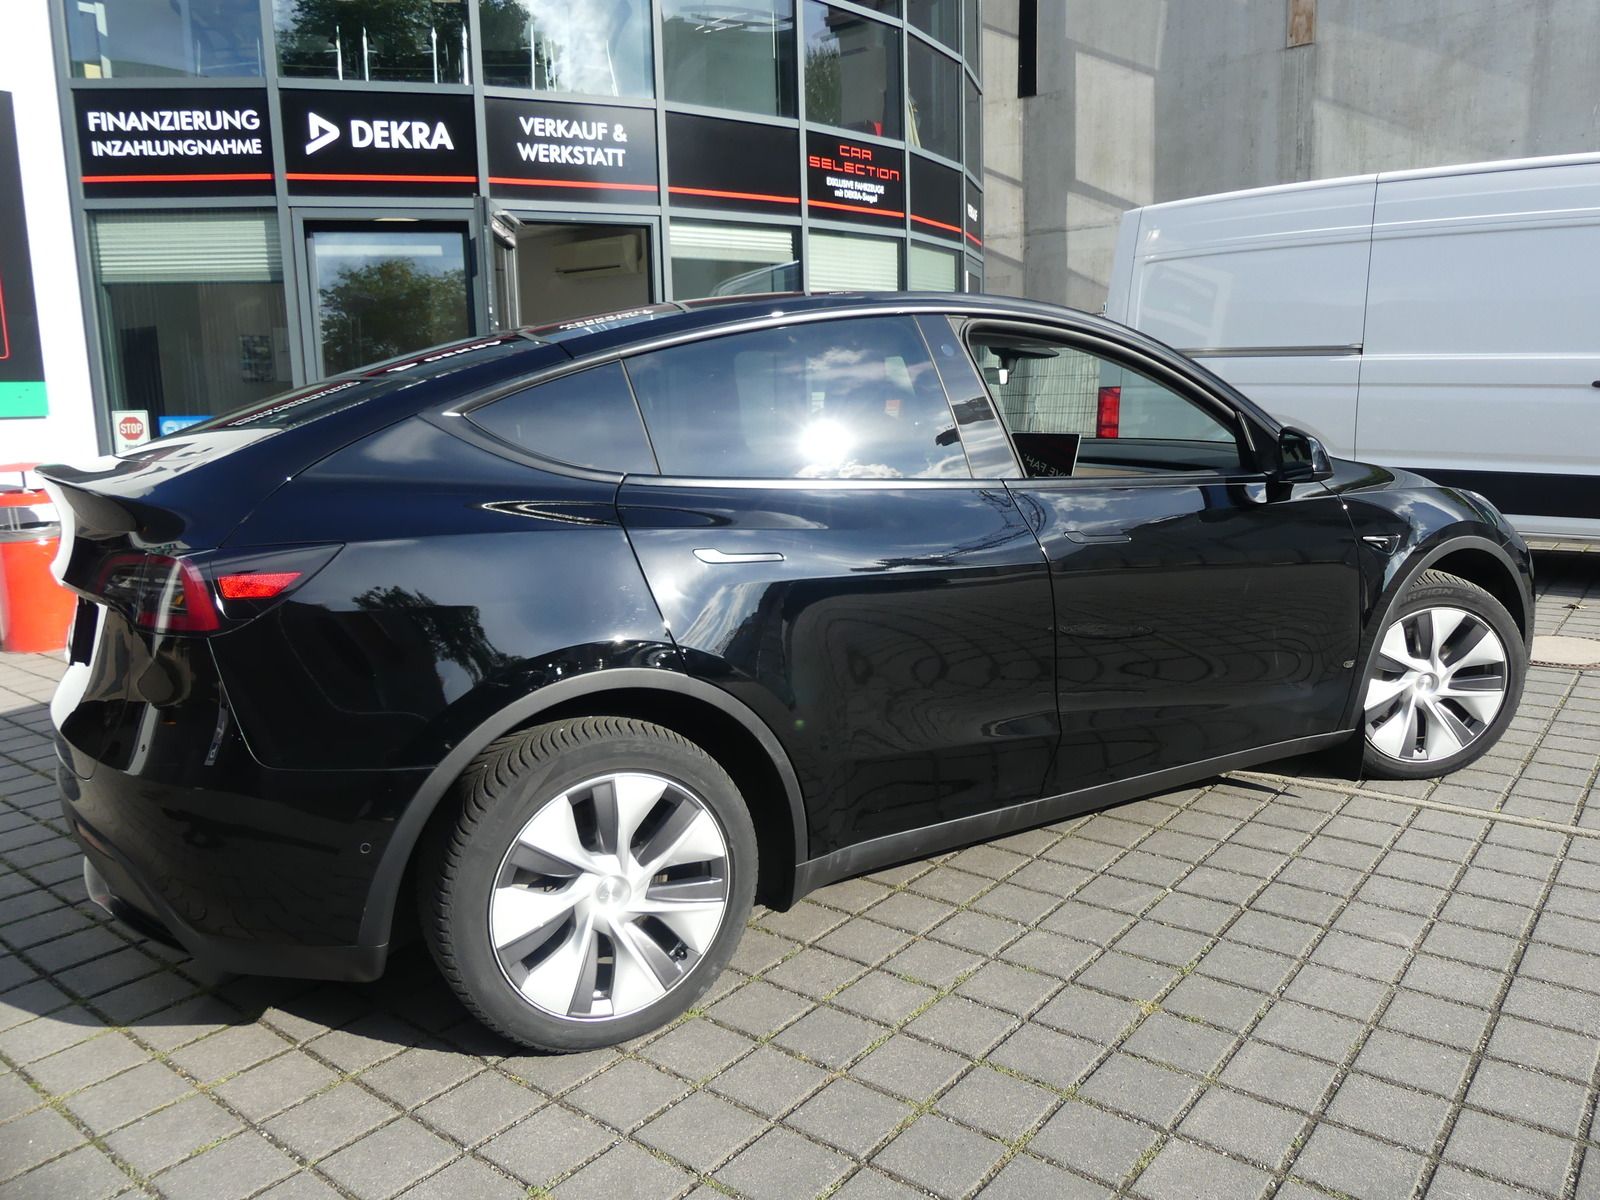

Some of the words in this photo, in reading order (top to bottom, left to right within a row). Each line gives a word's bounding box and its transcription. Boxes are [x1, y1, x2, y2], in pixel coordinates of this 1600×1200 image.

[87, 109, 261, 133] FINANZIERUNG
[519, 116, 608, 142] VERKAUF
[612, 124, 628, 143] &
[350, 119, 455, 150] DEKRA
[91, 138, 263, 157] INZAHLUNGNAHME
[516, 142, 626, 168] WERKSTATT
[838, 144, 873, 161] CAR
[808, 155, 900, 181] SELECTION
[120, 423, 143, 433] STOP
